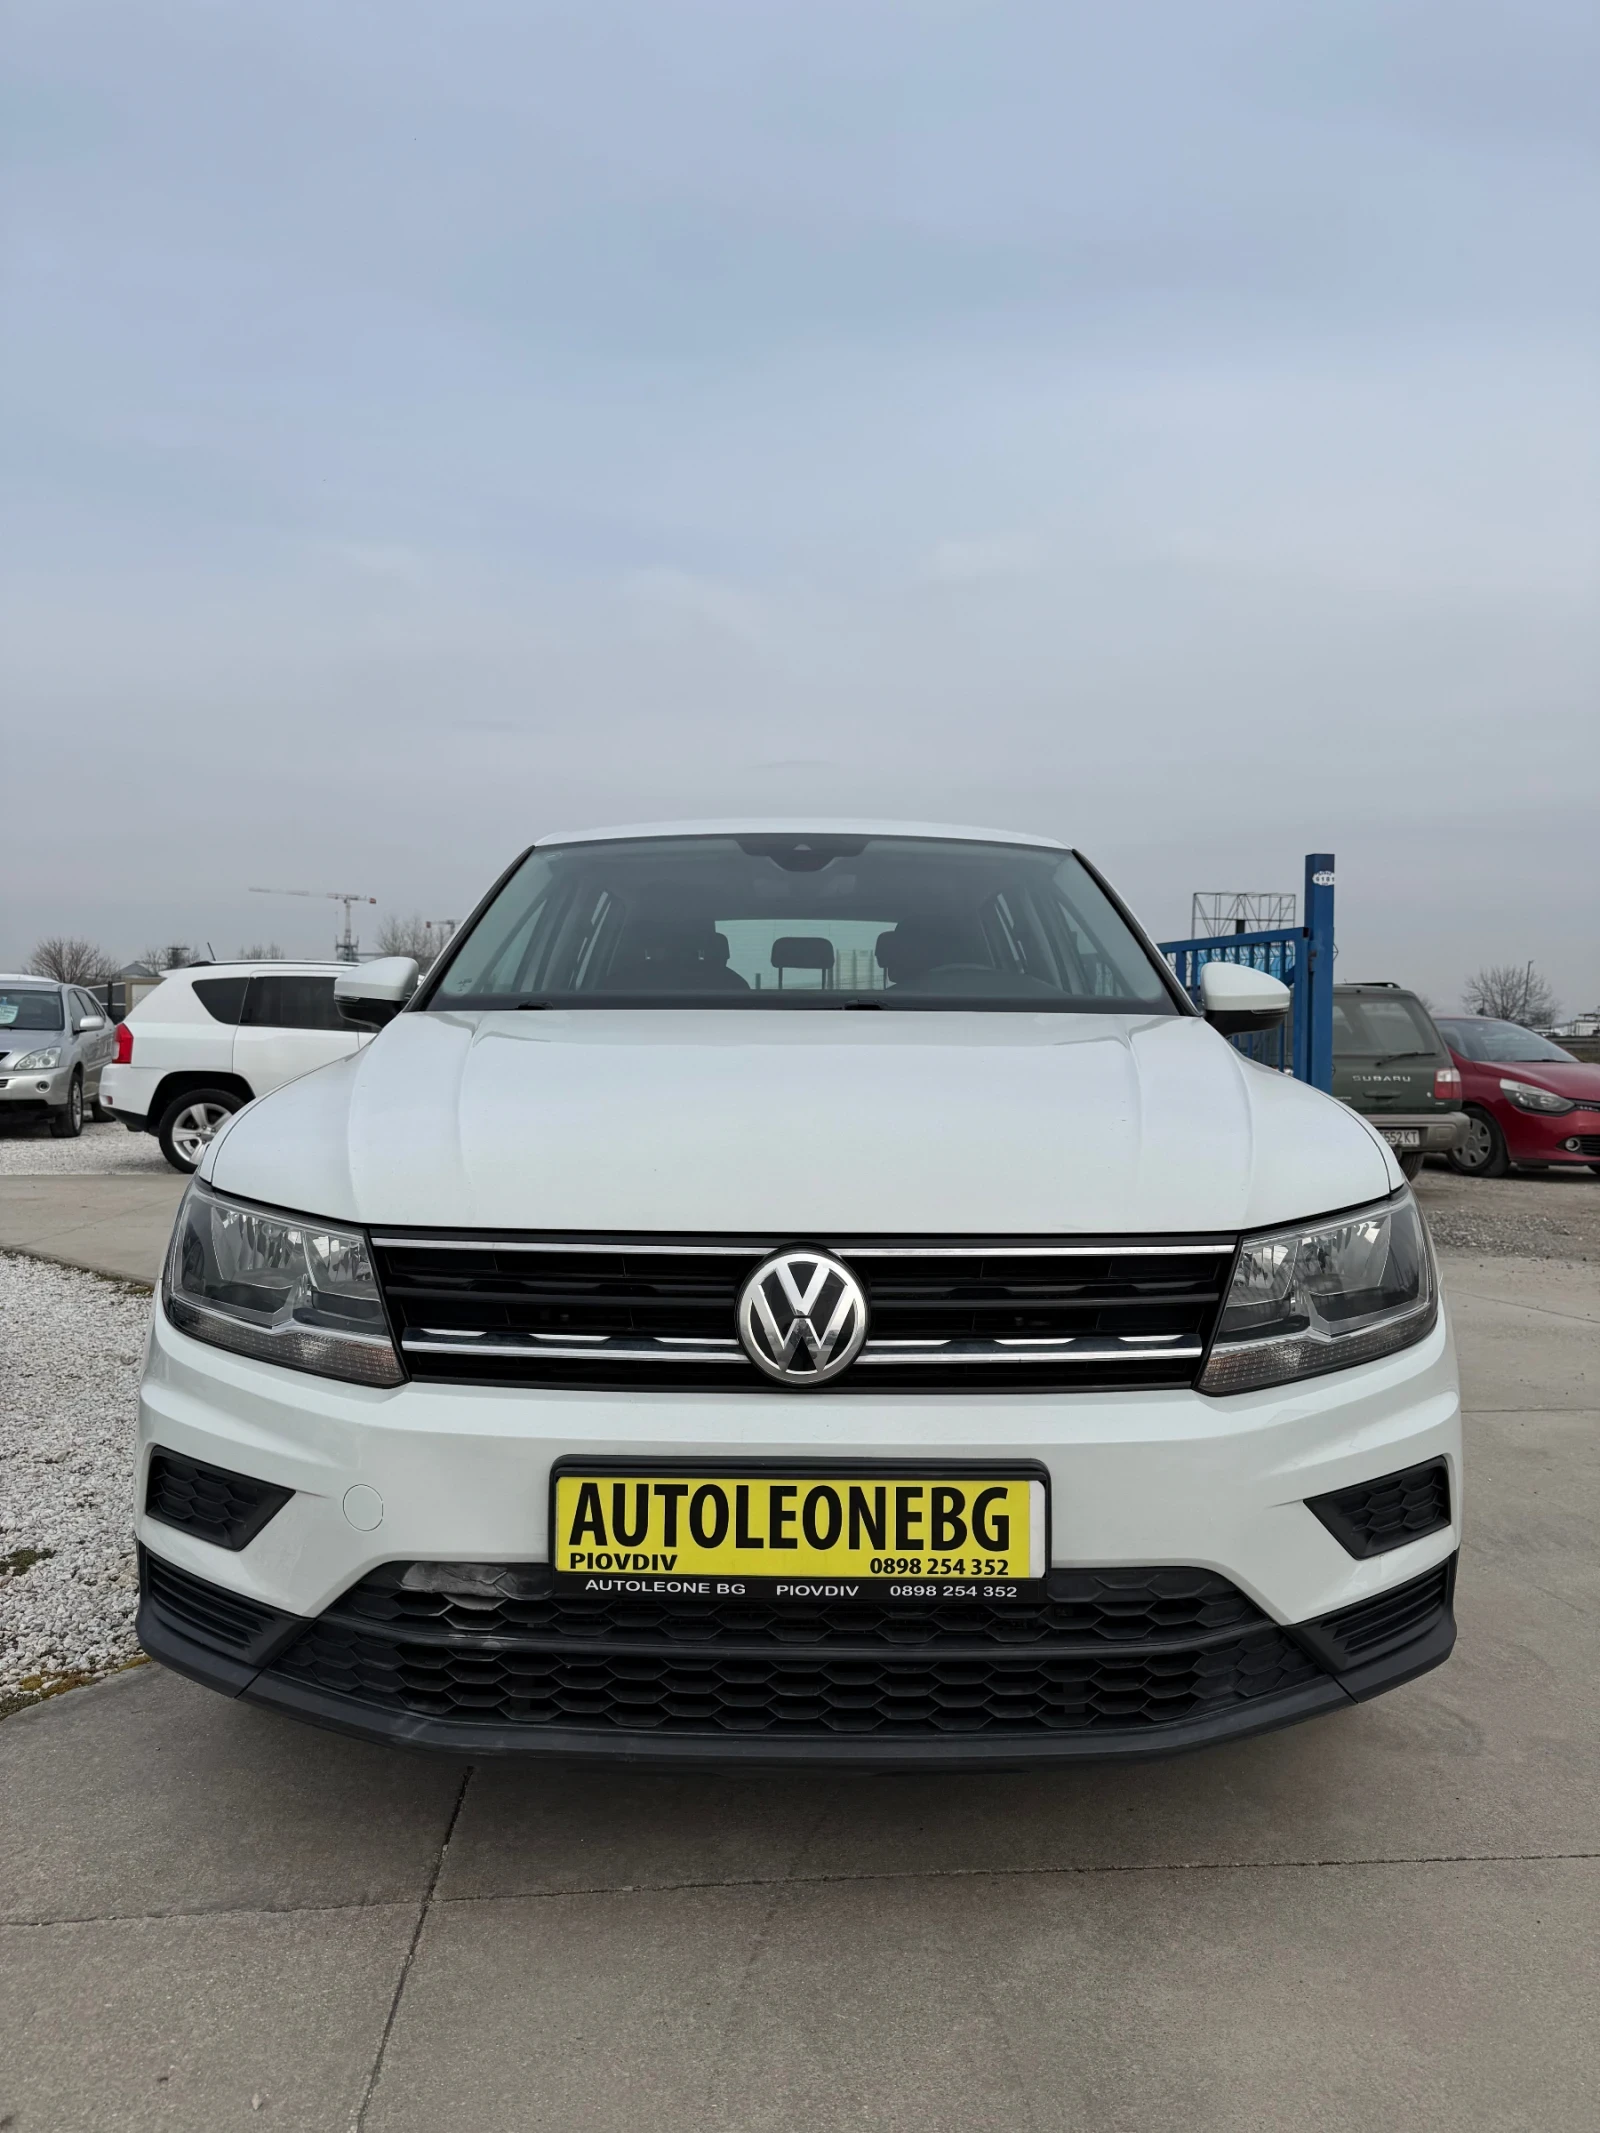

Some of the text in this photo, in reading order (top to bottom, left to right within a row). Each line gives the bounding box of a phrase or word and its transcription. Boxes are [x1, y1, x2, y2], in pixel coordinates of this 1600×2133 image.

[1379, 1130, 1417, 1144] 552KT
[568, 1482, 1010, 1552] AUTOLEONEBG
[569, 1552, 678, 1571] PIOVDIV
[870, 1557, 1009, 1576] 0898 254 352
[585, 1579, 746, 1595] AUTOLEONE BG
[776, 1584, 859, 1597] PIOVDIV
[889, 1585, 1018, 1598] 0898 254 352
